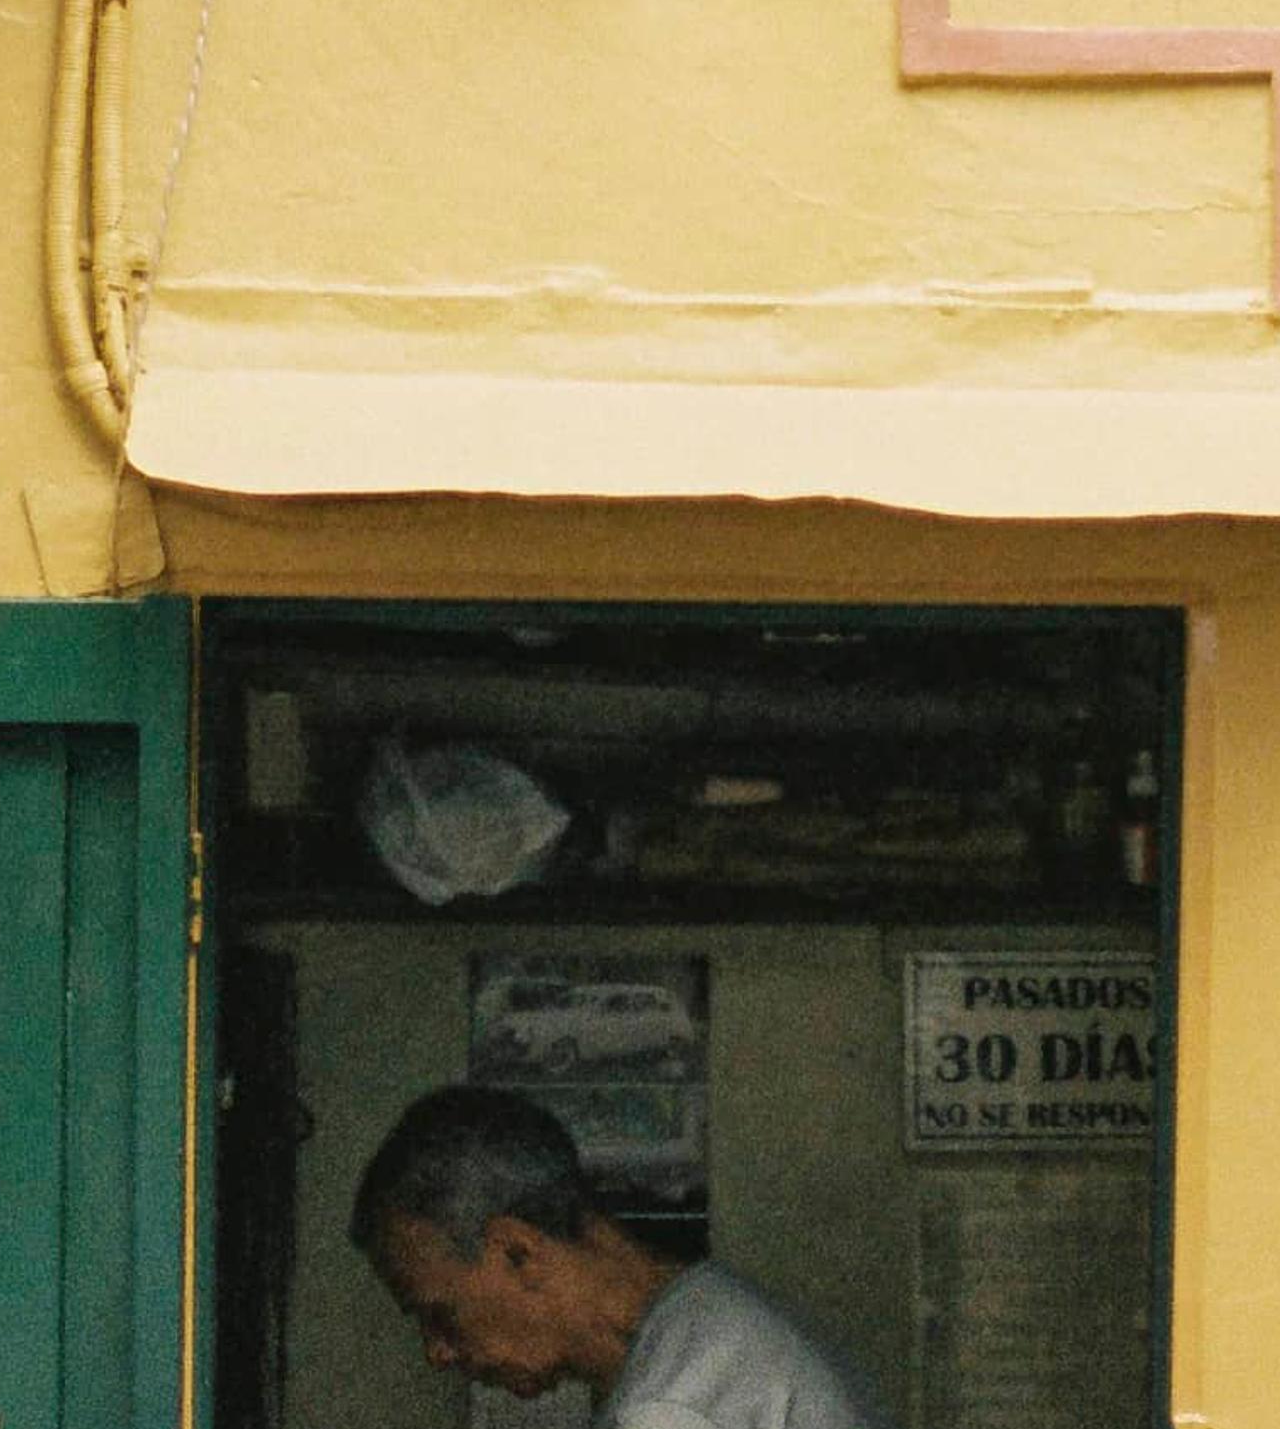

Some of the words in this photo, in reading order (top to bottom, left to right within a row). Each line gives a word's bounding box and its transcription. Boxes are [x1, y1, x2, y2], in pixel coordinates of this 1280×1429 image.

[963, 975, 1152, 1010] PASADOS
[935, 1033, 1017, 1083] 30
[924, 1102, 969, 1127] NO
[978, 1102, 1017, 1126] SE
